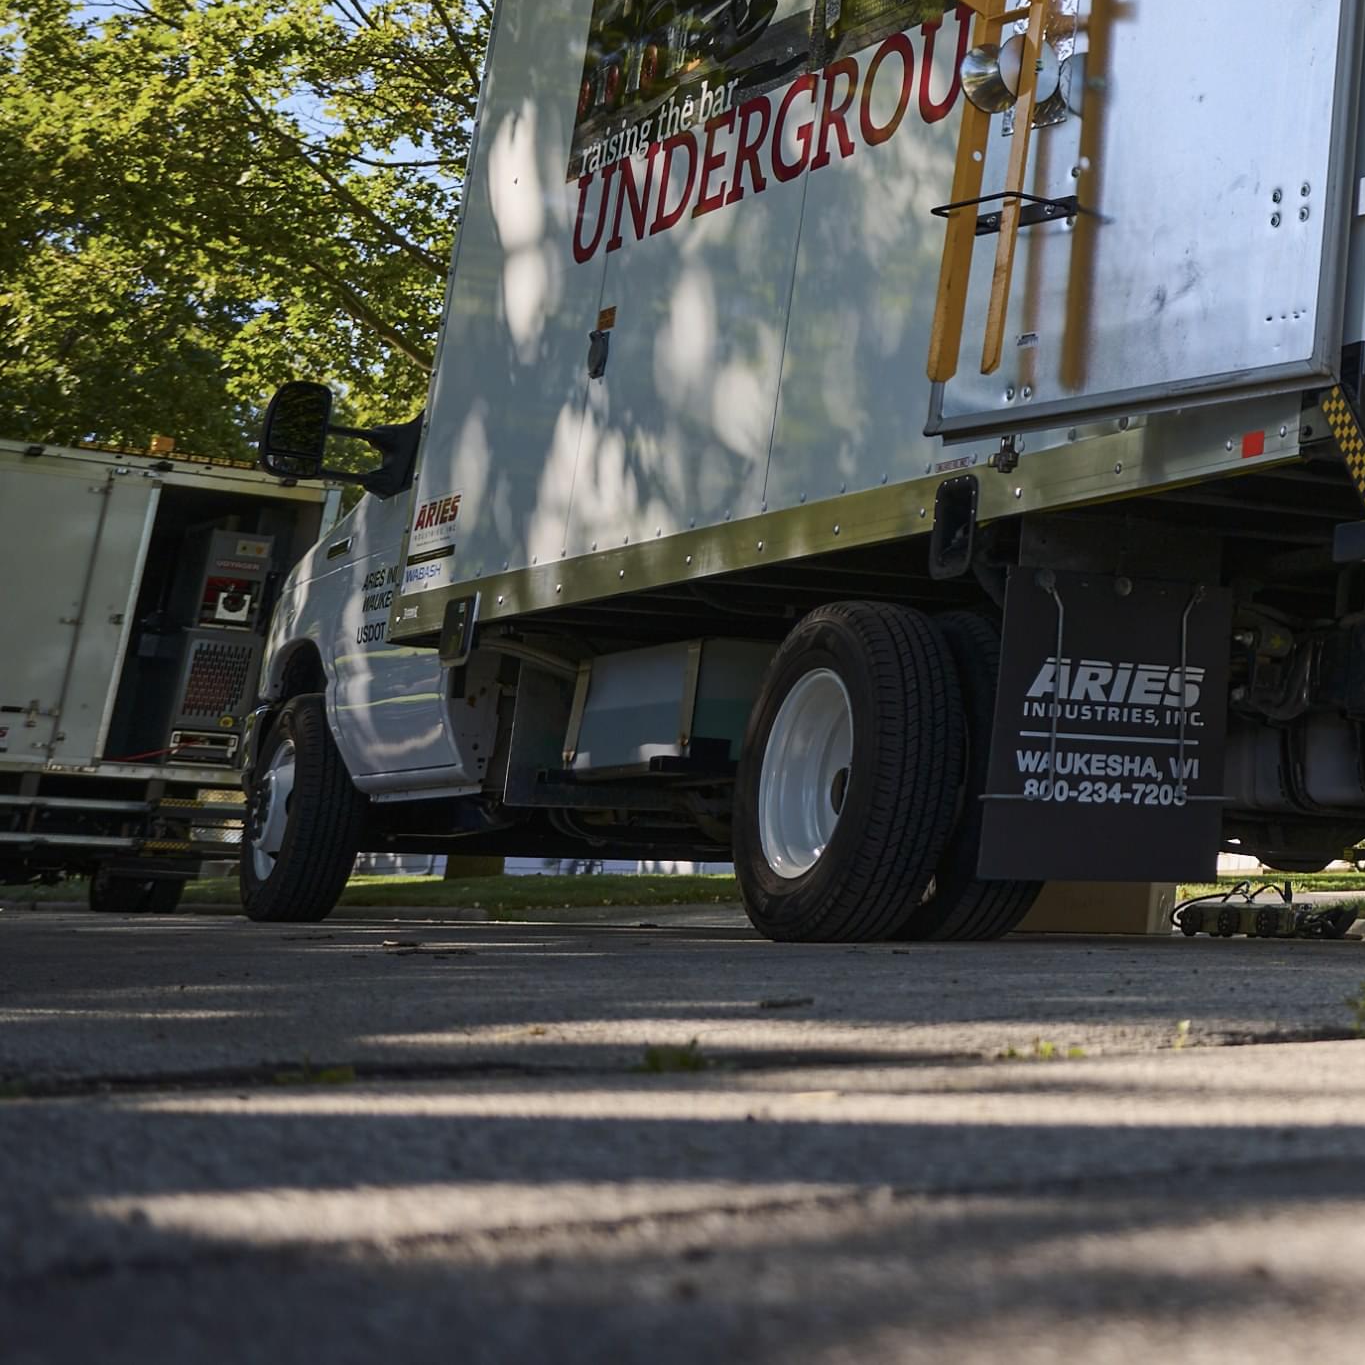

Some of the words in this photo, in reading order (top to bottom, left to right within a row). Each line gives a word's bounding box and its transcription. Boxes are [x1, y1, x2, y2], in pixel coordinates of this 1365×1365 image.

[579, 119, 653, 177] raising
[656, 95, 694, 142] the
[701, 78, 739, 122] bar
[414, 494, 462, 531] ARIES
[362, 568, 386, 591] ARIES
[405, 563, 442, 583] WABASH
[356, 621, 387, 644] USDOT
[1026, 657, 1206, 707] ARIES
[1023, 701, 1160, 726] INDUSTRIES,
[1165, 710, 1205, 726] INC.
[1016, 749, 1164, 781] WAUKESHA,
[1169, 757, 1199, 779] WI
[1023, 779, 1188, 806] 800-234-7205
